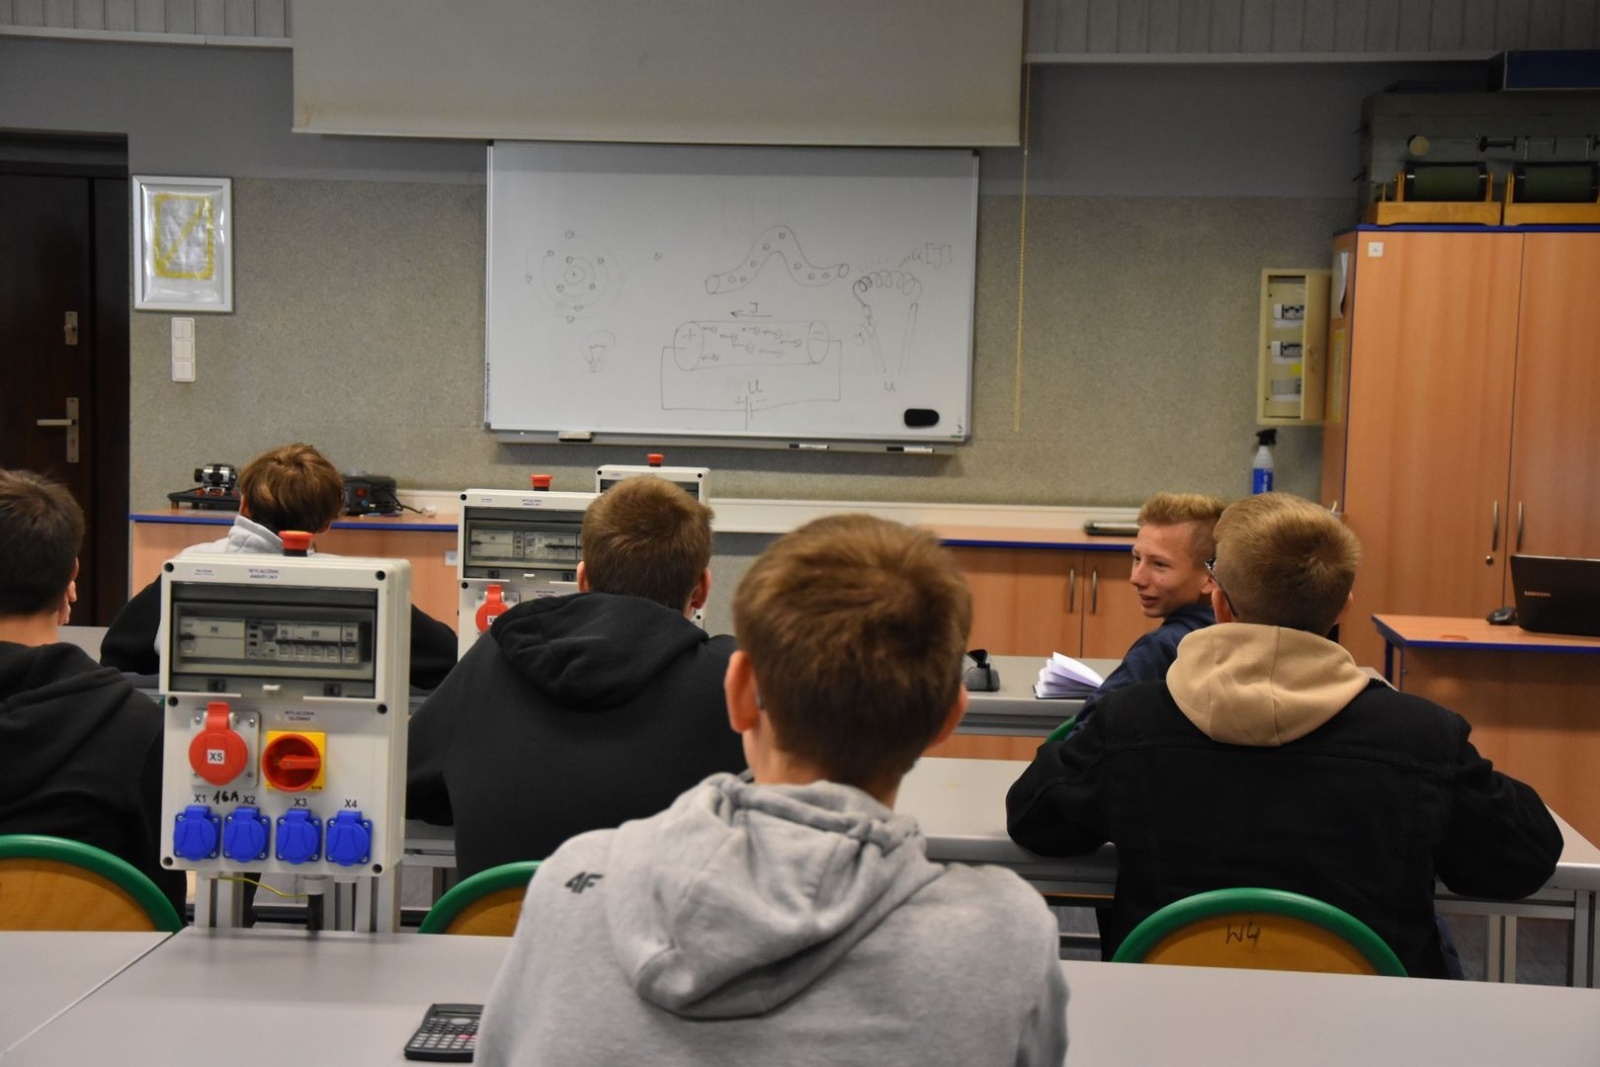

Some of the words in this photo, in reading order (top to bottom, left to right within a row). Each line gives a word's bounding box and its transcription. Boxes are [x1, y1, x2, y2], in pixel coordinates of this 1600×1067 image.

[210, 752, 223, 761] X5
[194, 793, 206, 803] X1
[213, 790, 239, 805] 16A
[242, 794, 256, 805] X2
[294, 797, 307, 807] X3
[344, 798, 357, 808] X4
